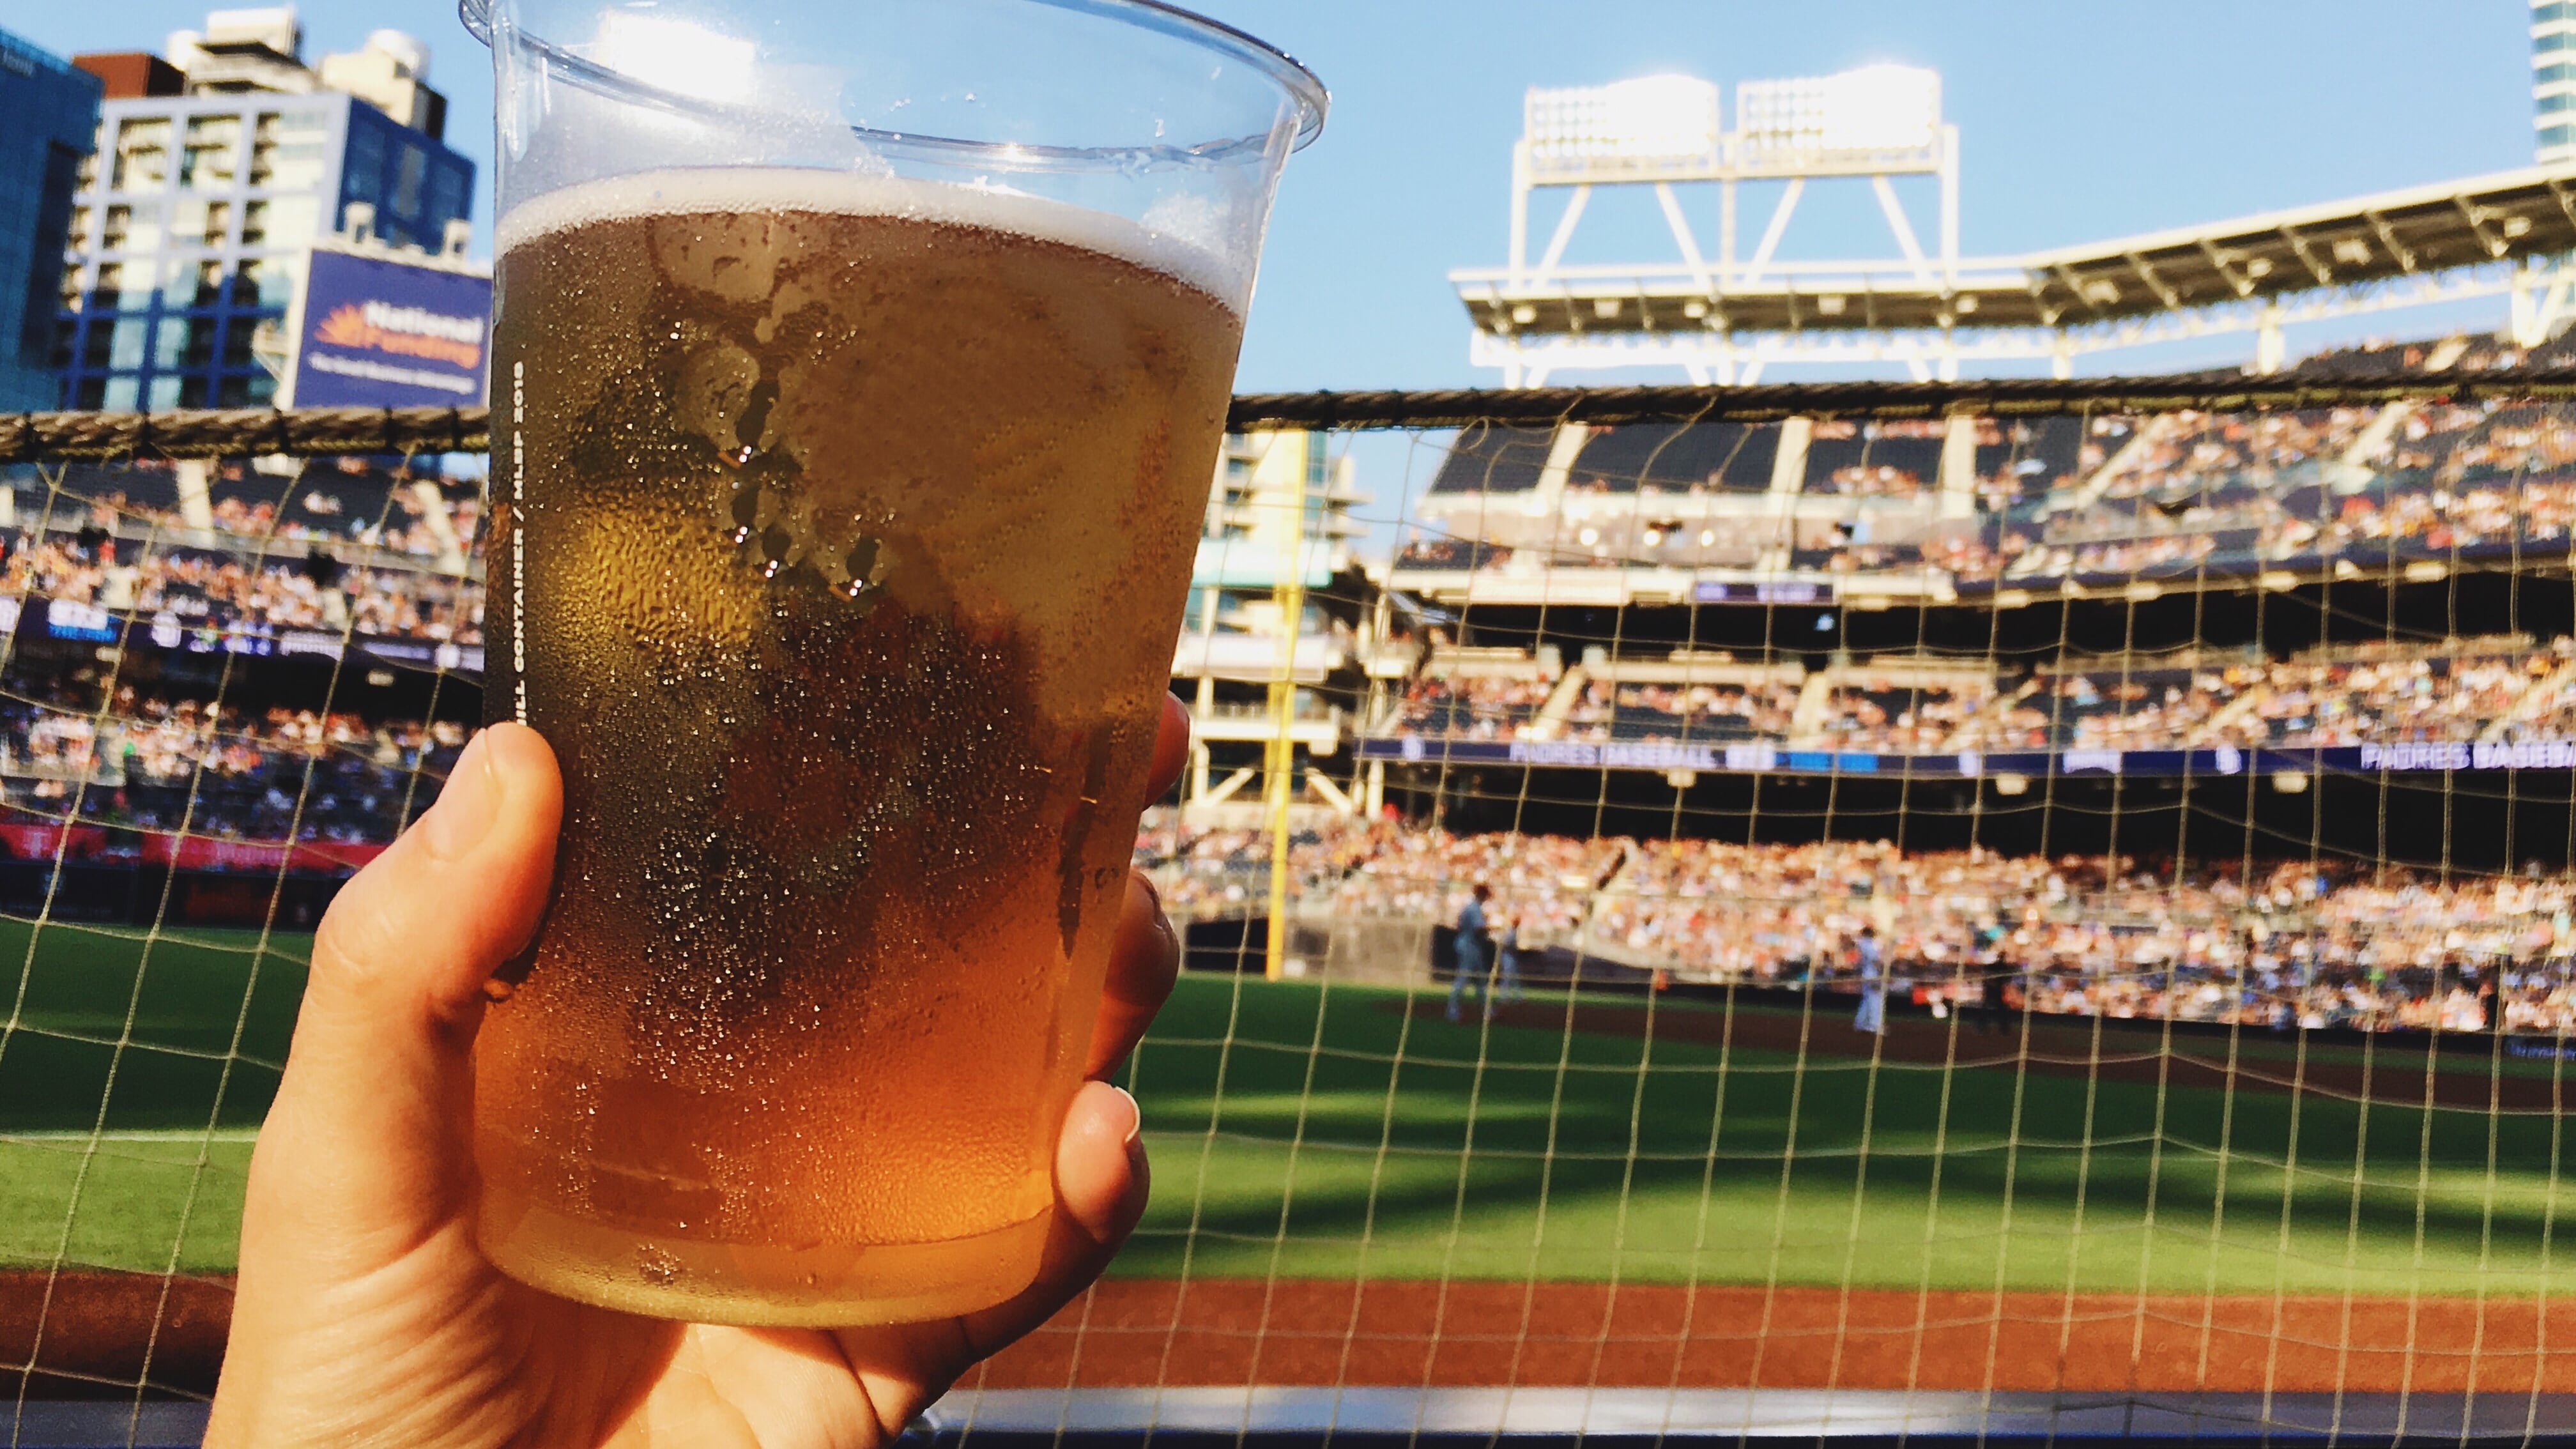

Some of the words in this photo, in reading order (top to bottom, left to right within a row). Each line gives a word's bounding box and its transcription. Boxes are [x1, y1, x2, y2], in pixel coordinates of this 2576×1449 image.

[513, 430, 524, 500] MLBP
[512, 506, 525, 522] /
[513, 528, 525, 673] CONTAINER
[2361, 741, 2471, 770] PADRES
